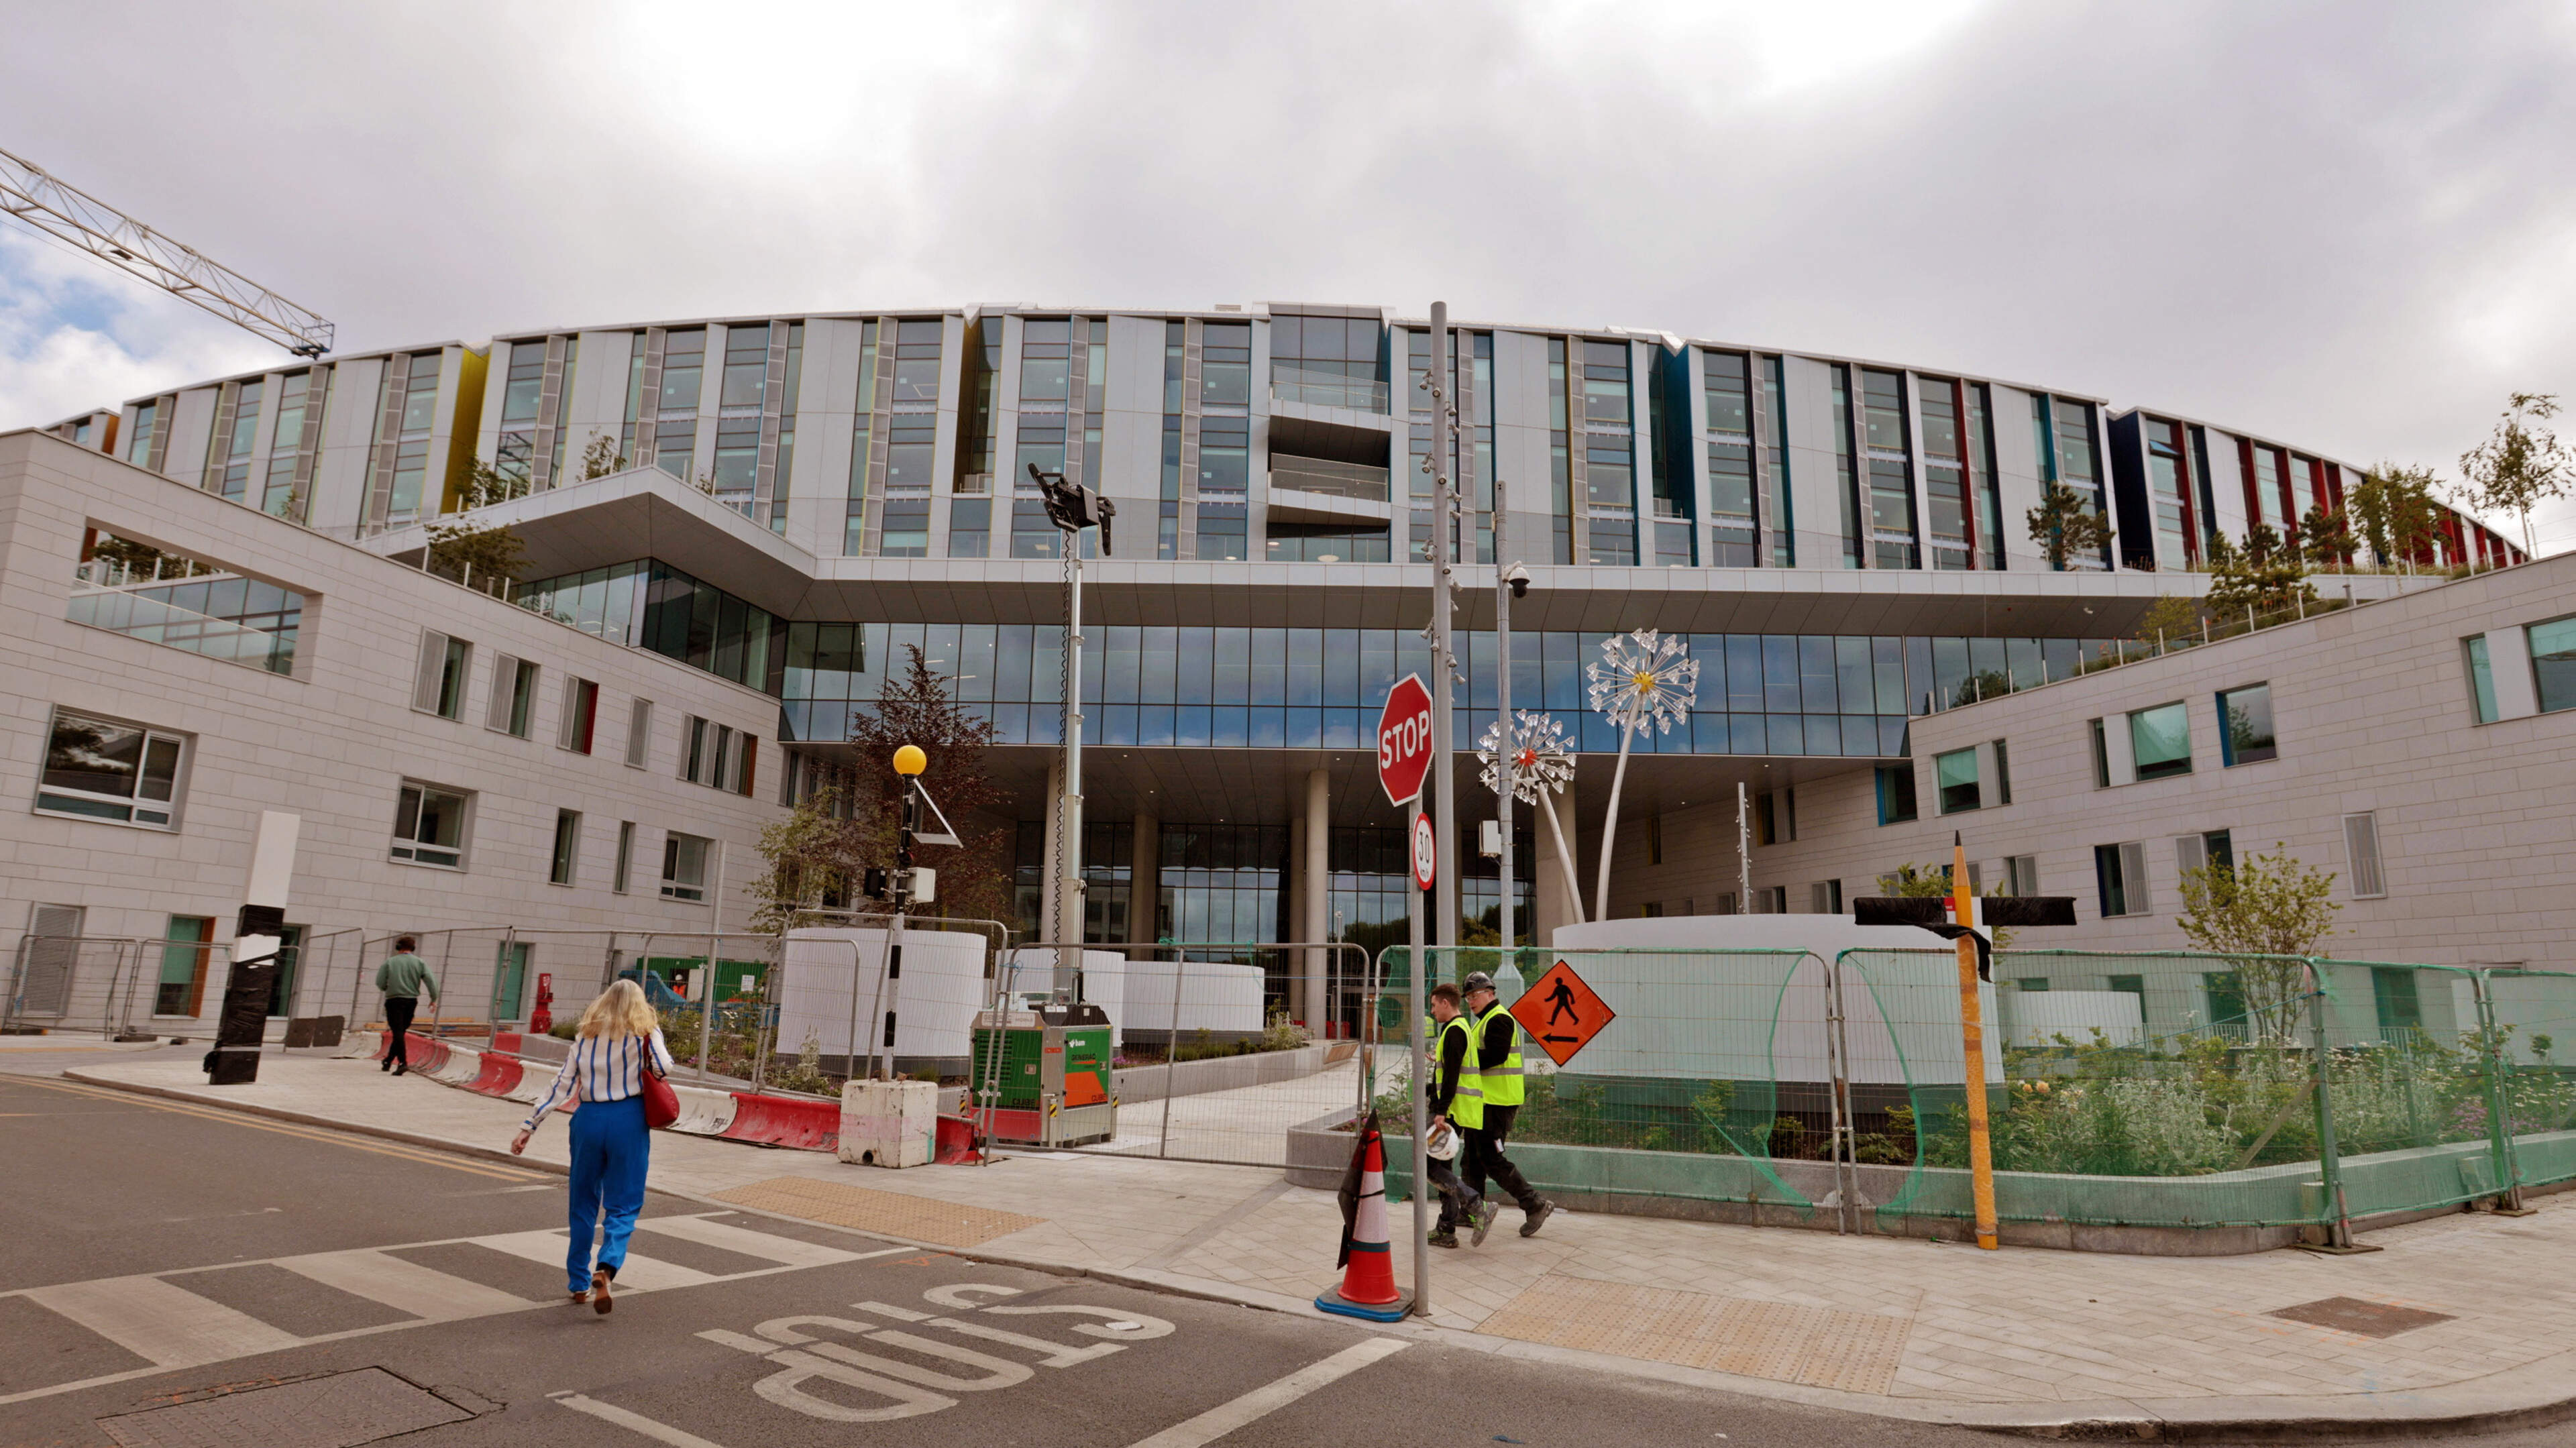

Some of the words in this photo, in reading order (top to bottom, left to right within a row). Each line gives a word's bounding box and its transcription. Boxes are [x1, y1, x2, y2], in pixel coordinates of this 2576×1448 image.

[1381, 710, 1430, 769] STOP
[1419, 832, 1430, 864] 30
[1071, 1053, 1095, 1061] GENERAC
[694, 1283, 1176, 1422] STOP
